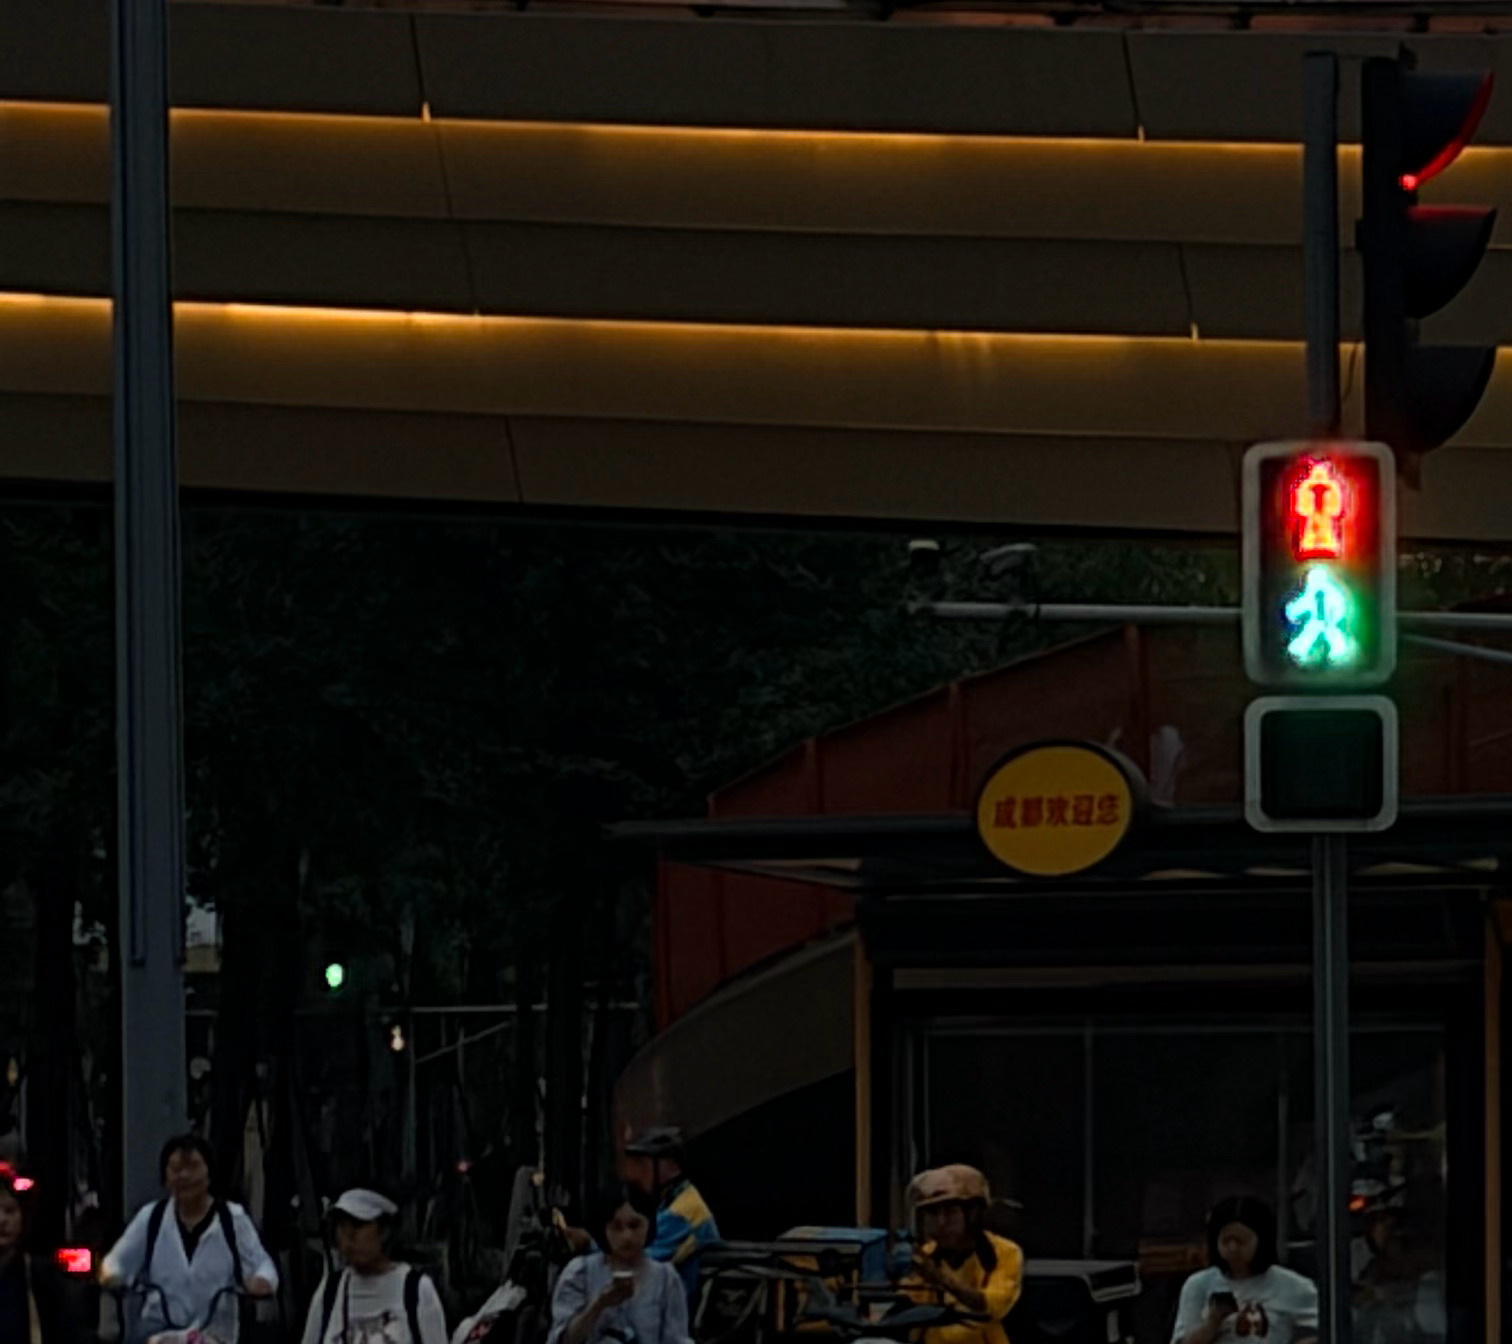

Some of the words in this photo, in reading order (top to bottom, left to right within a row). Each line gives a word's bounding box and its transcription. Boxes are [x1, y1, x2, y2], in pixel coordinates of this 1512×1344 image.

[993, 793, 1121, 829] 成都欢迎您
